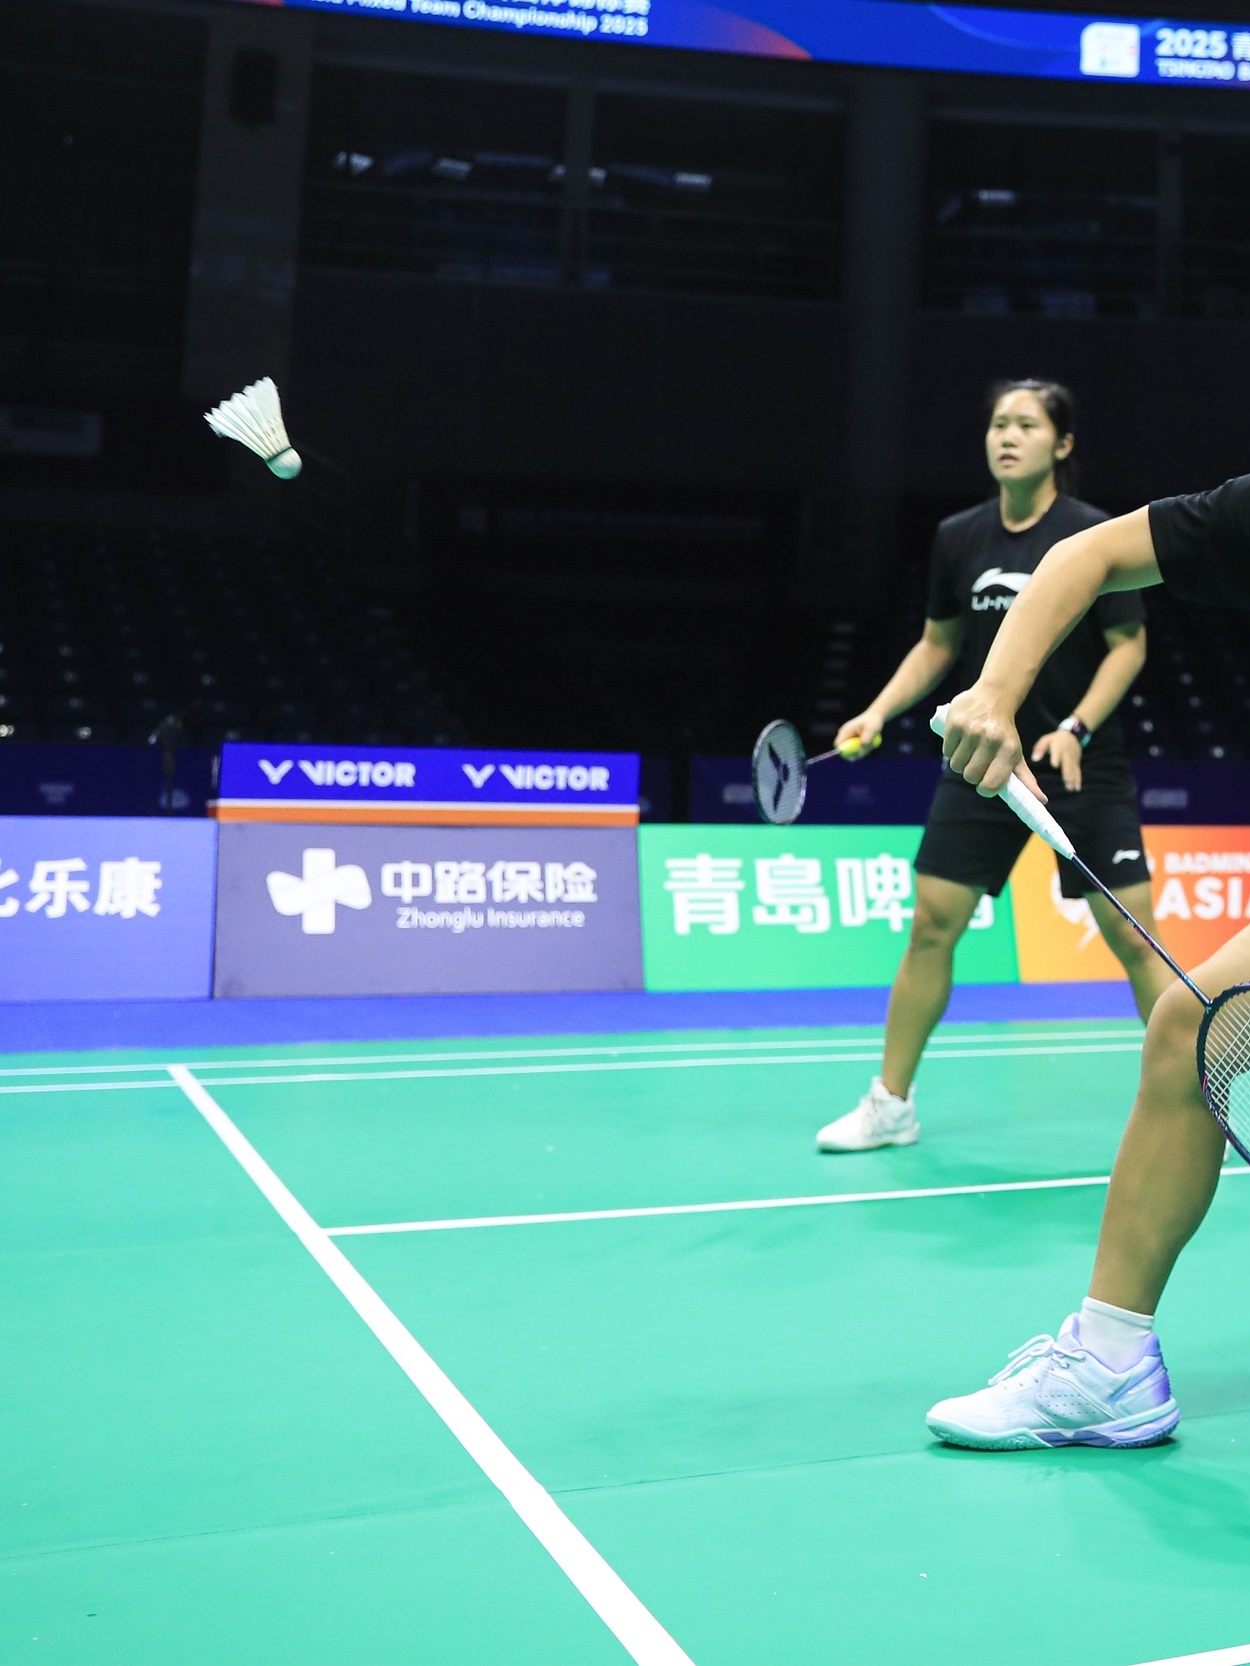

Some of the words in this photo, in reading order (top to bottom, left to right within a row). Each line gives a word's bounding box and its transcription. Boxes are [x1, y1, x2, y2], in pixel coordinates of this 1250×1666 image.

[461, 0, 598, 35] Championship
[1155, 28, 1229, 59] 2025
[971, 595, 1016, 611] LI-N
[298, 760, 416, 788] VICTOR
[500, 764, 610, 791] VICTOR
[381, 860, 598, 904] 中路保险
[396, 906, 485, 933] Zhonglu
[487, 907, 586, 928] Insurance
